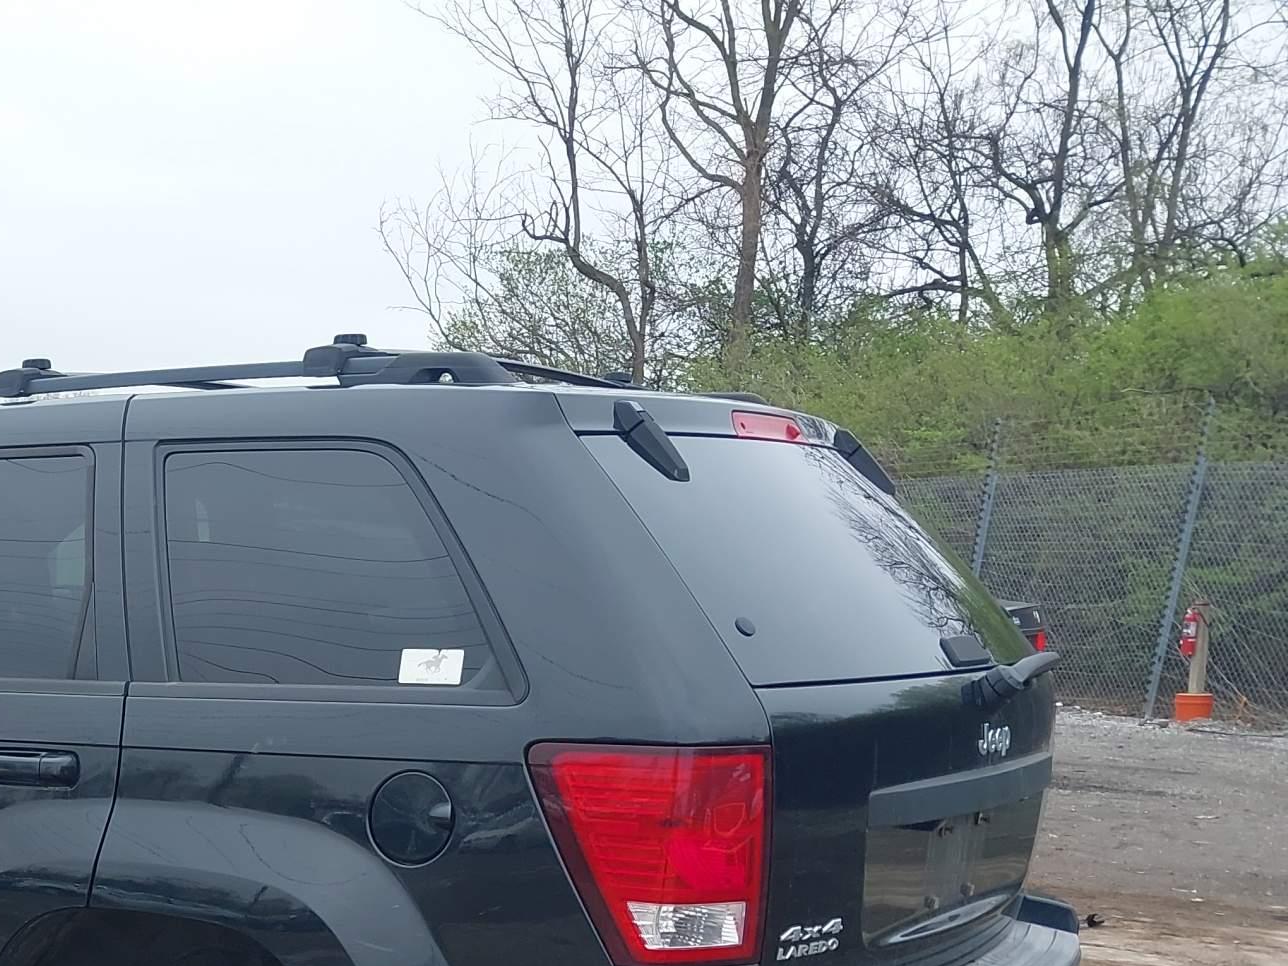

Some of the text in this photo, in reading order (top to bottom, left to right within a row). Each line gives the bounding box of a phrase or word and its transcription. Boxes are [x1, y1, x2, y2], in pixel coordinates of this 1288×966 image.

[978, 722, 1011, 757] Jeep
[779, 917, 844, 941] 4x4
[776, 937, 839, 961] LAREDO
